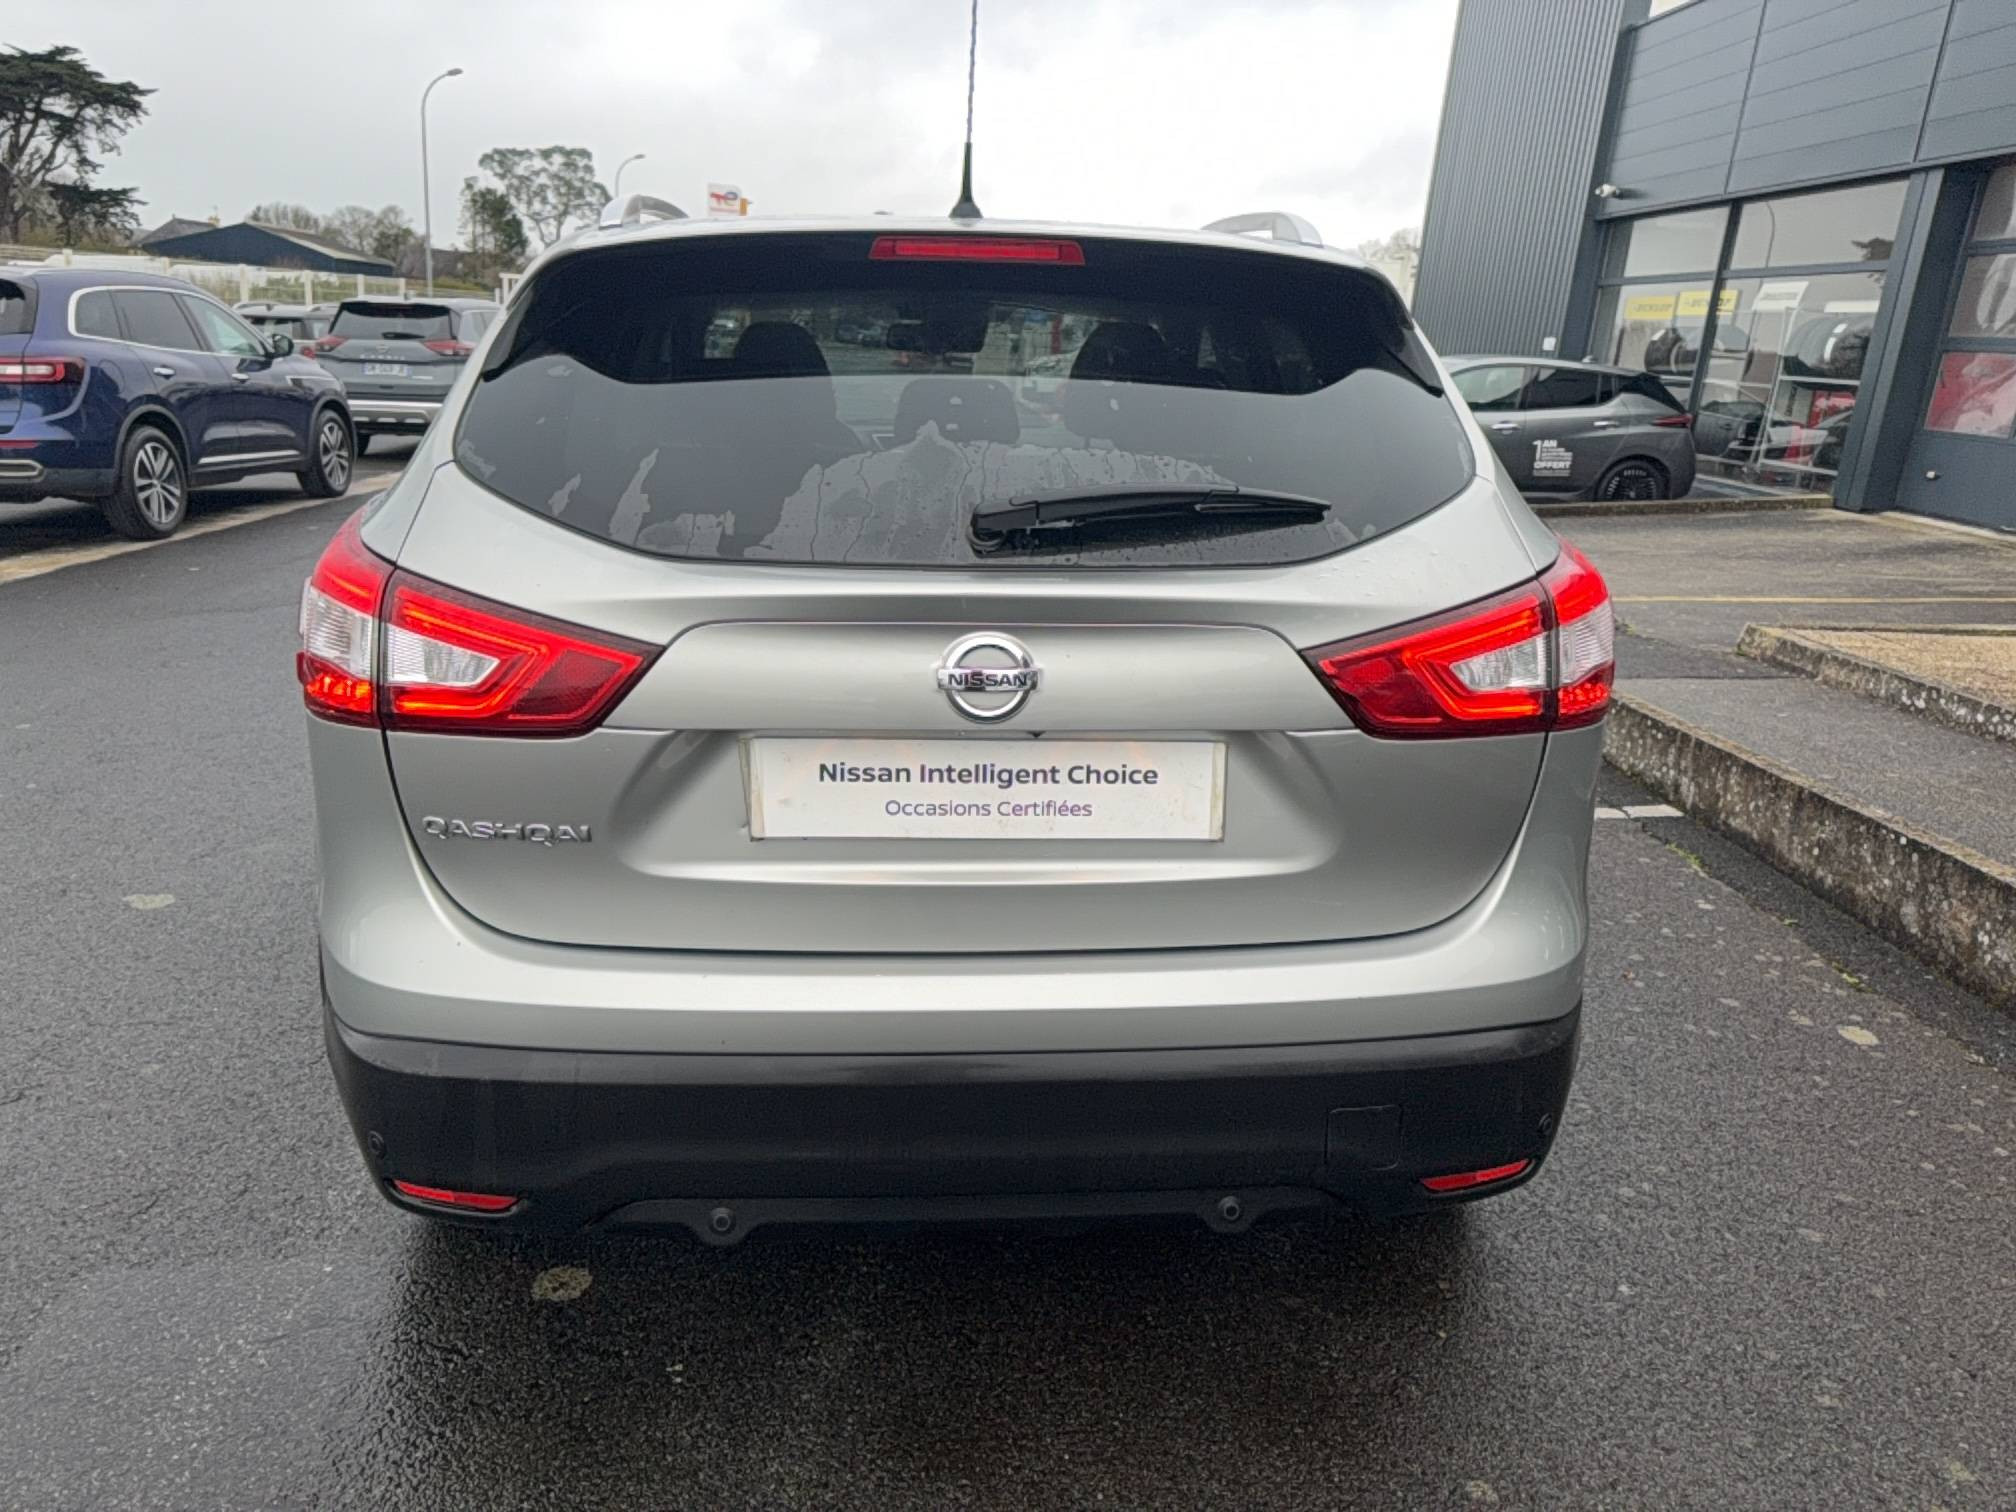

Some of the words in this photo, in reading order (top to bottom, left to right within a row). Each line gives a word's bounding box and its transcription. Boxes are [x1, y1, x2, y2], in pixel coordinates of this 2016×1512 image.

[948, 673, 1028, 687] NISSAN
[819, 763, 911, 784] Nissan
[920, 763, 1061, 788] Intelligent
[1068, 764, 1158, 785] Choice
[885, 799, 991, 817] Occasions
[997, 799, 1093, 817] Certifiées
[422, 815, 593, 847] QASHQAI
